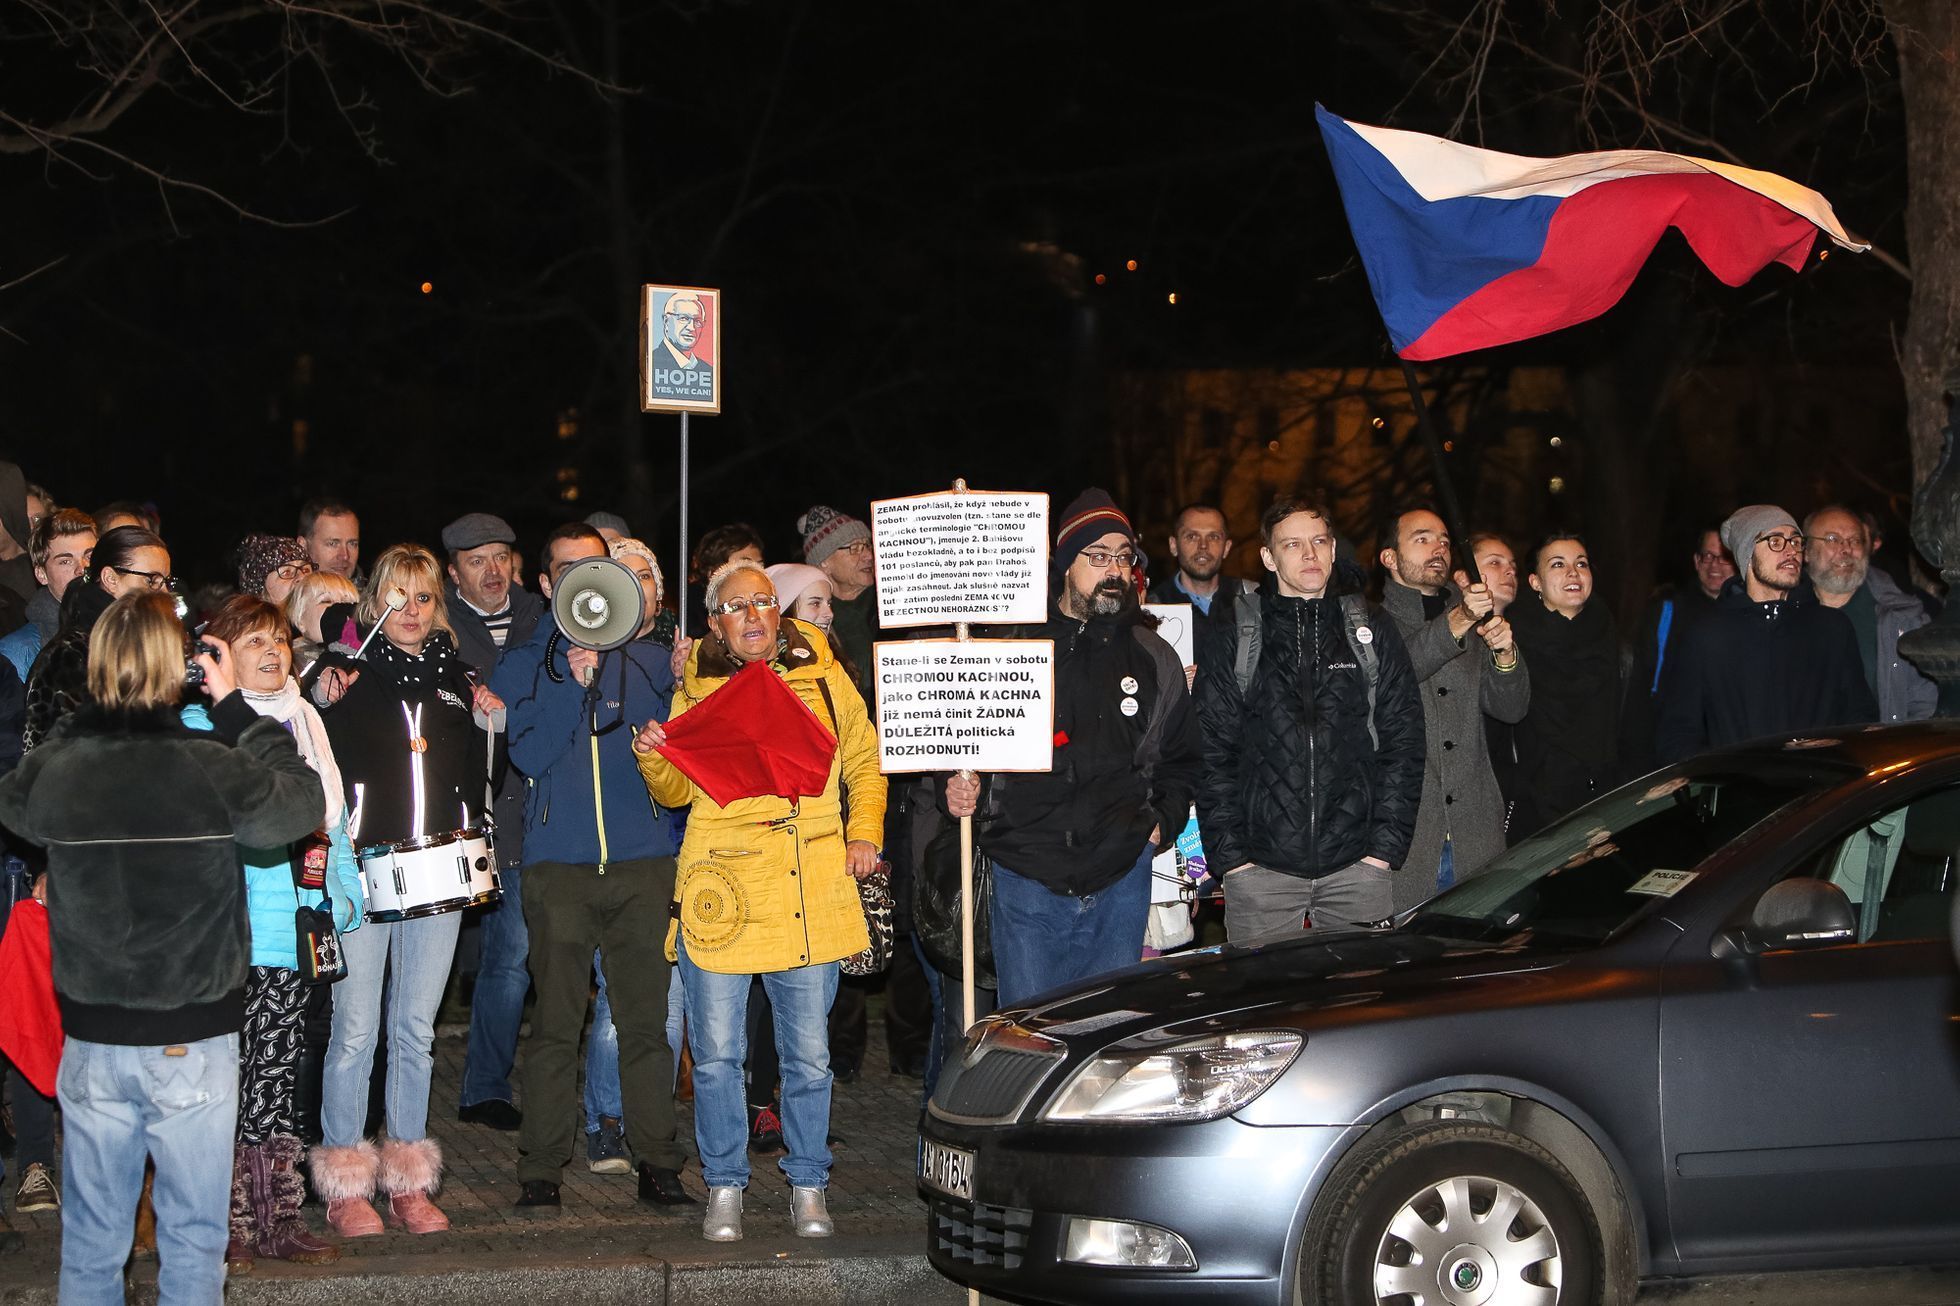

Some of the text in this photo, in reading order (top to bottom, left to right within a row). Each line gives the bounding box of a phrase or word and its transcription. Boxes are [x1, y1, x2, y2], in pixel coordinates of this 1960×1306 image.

[654, 369, 711, 387] HOPE
[691, 388, 711, 396] CAN!
[877, 504, 910, 514] ZEMAN
[966, 500, 986, 509] když
[920, 524, 971, 533] terminologie
[938, 536, 969, 545] jmenuje
[960, 559, 974, 567] pak
[882, 656, 929, 666] Stane-li
[934, 656, 946, 664] se
[950, 656, 990, 664] Zeman
[1006, 655, 1048, 664] sobotu
[883, 672, 1034, 684] CHROMOU KACHNOU,
[882, 688, 1041, 704] jako CHROMÁ KACHNA
[883, 706, 1025, 722] již nemá činit ŽÁDNÁ
[885, 724, 1015, 739] DŮLEŽITÁ politická
[886, 742, 980, 756] ROZHODNUTÍ!
